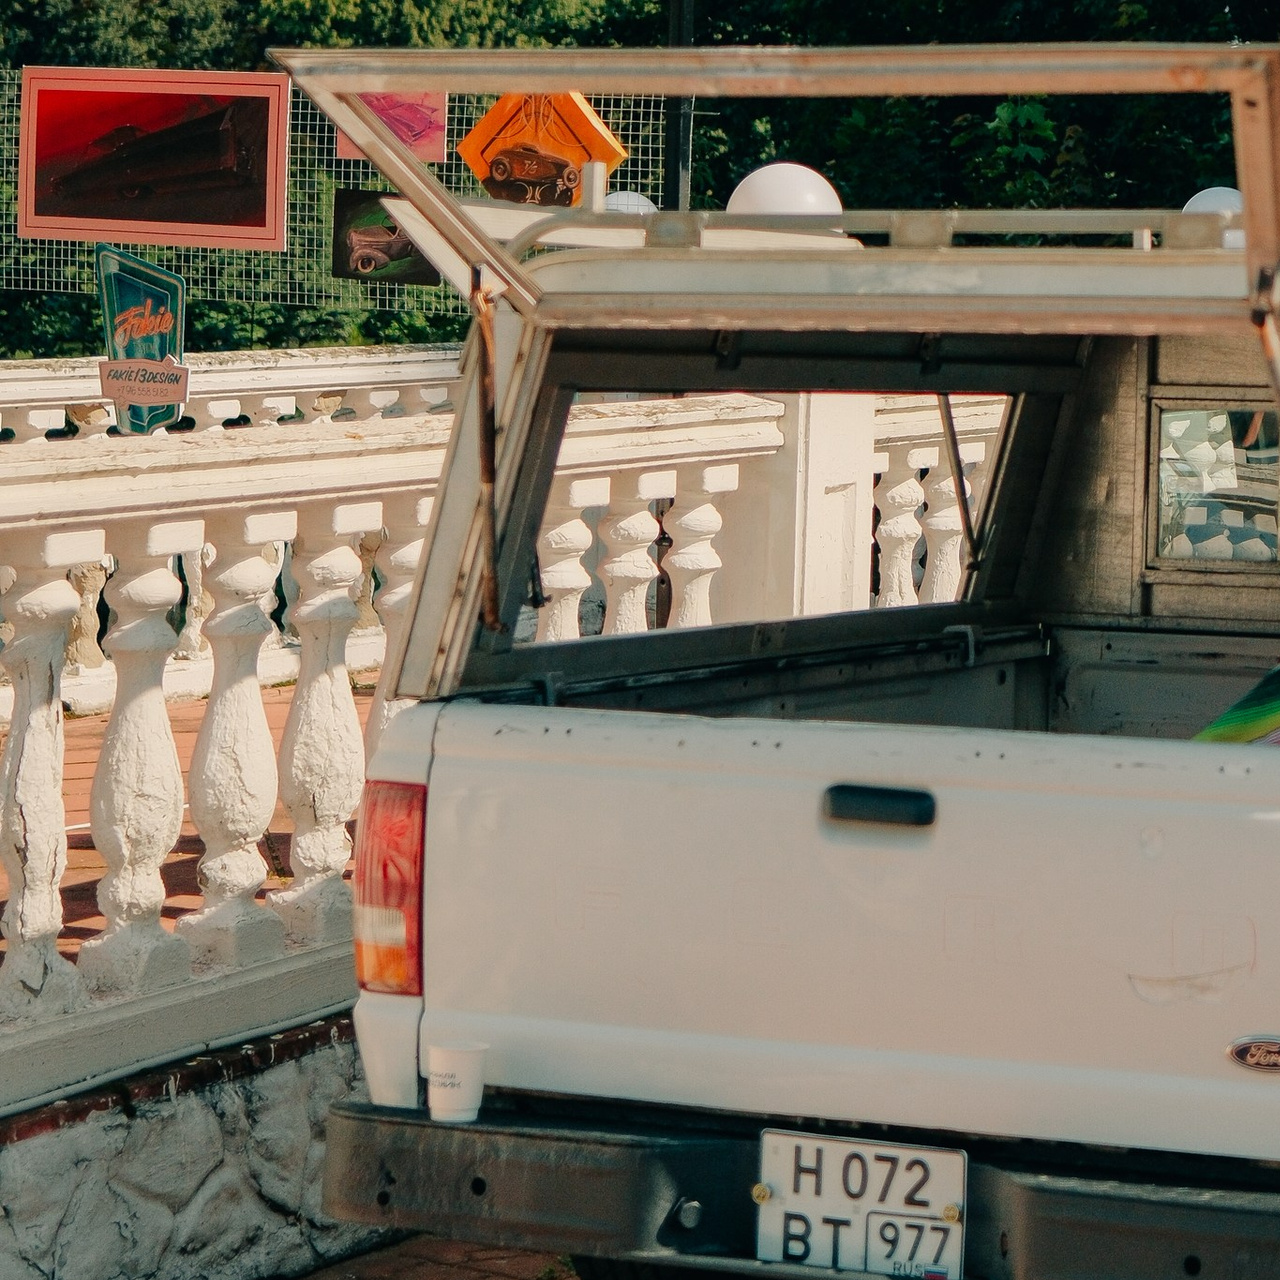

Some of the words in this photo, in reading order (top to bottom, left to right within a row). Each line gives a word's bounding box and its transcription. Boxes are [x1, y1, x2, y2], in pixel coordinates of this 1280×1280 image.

[114, 299, 174, 349] Fakie
[842, 1150, 931, 1207] 072
[783, 1210, 851, 1269] BT
[879, 1220, 950, 1264] 977
